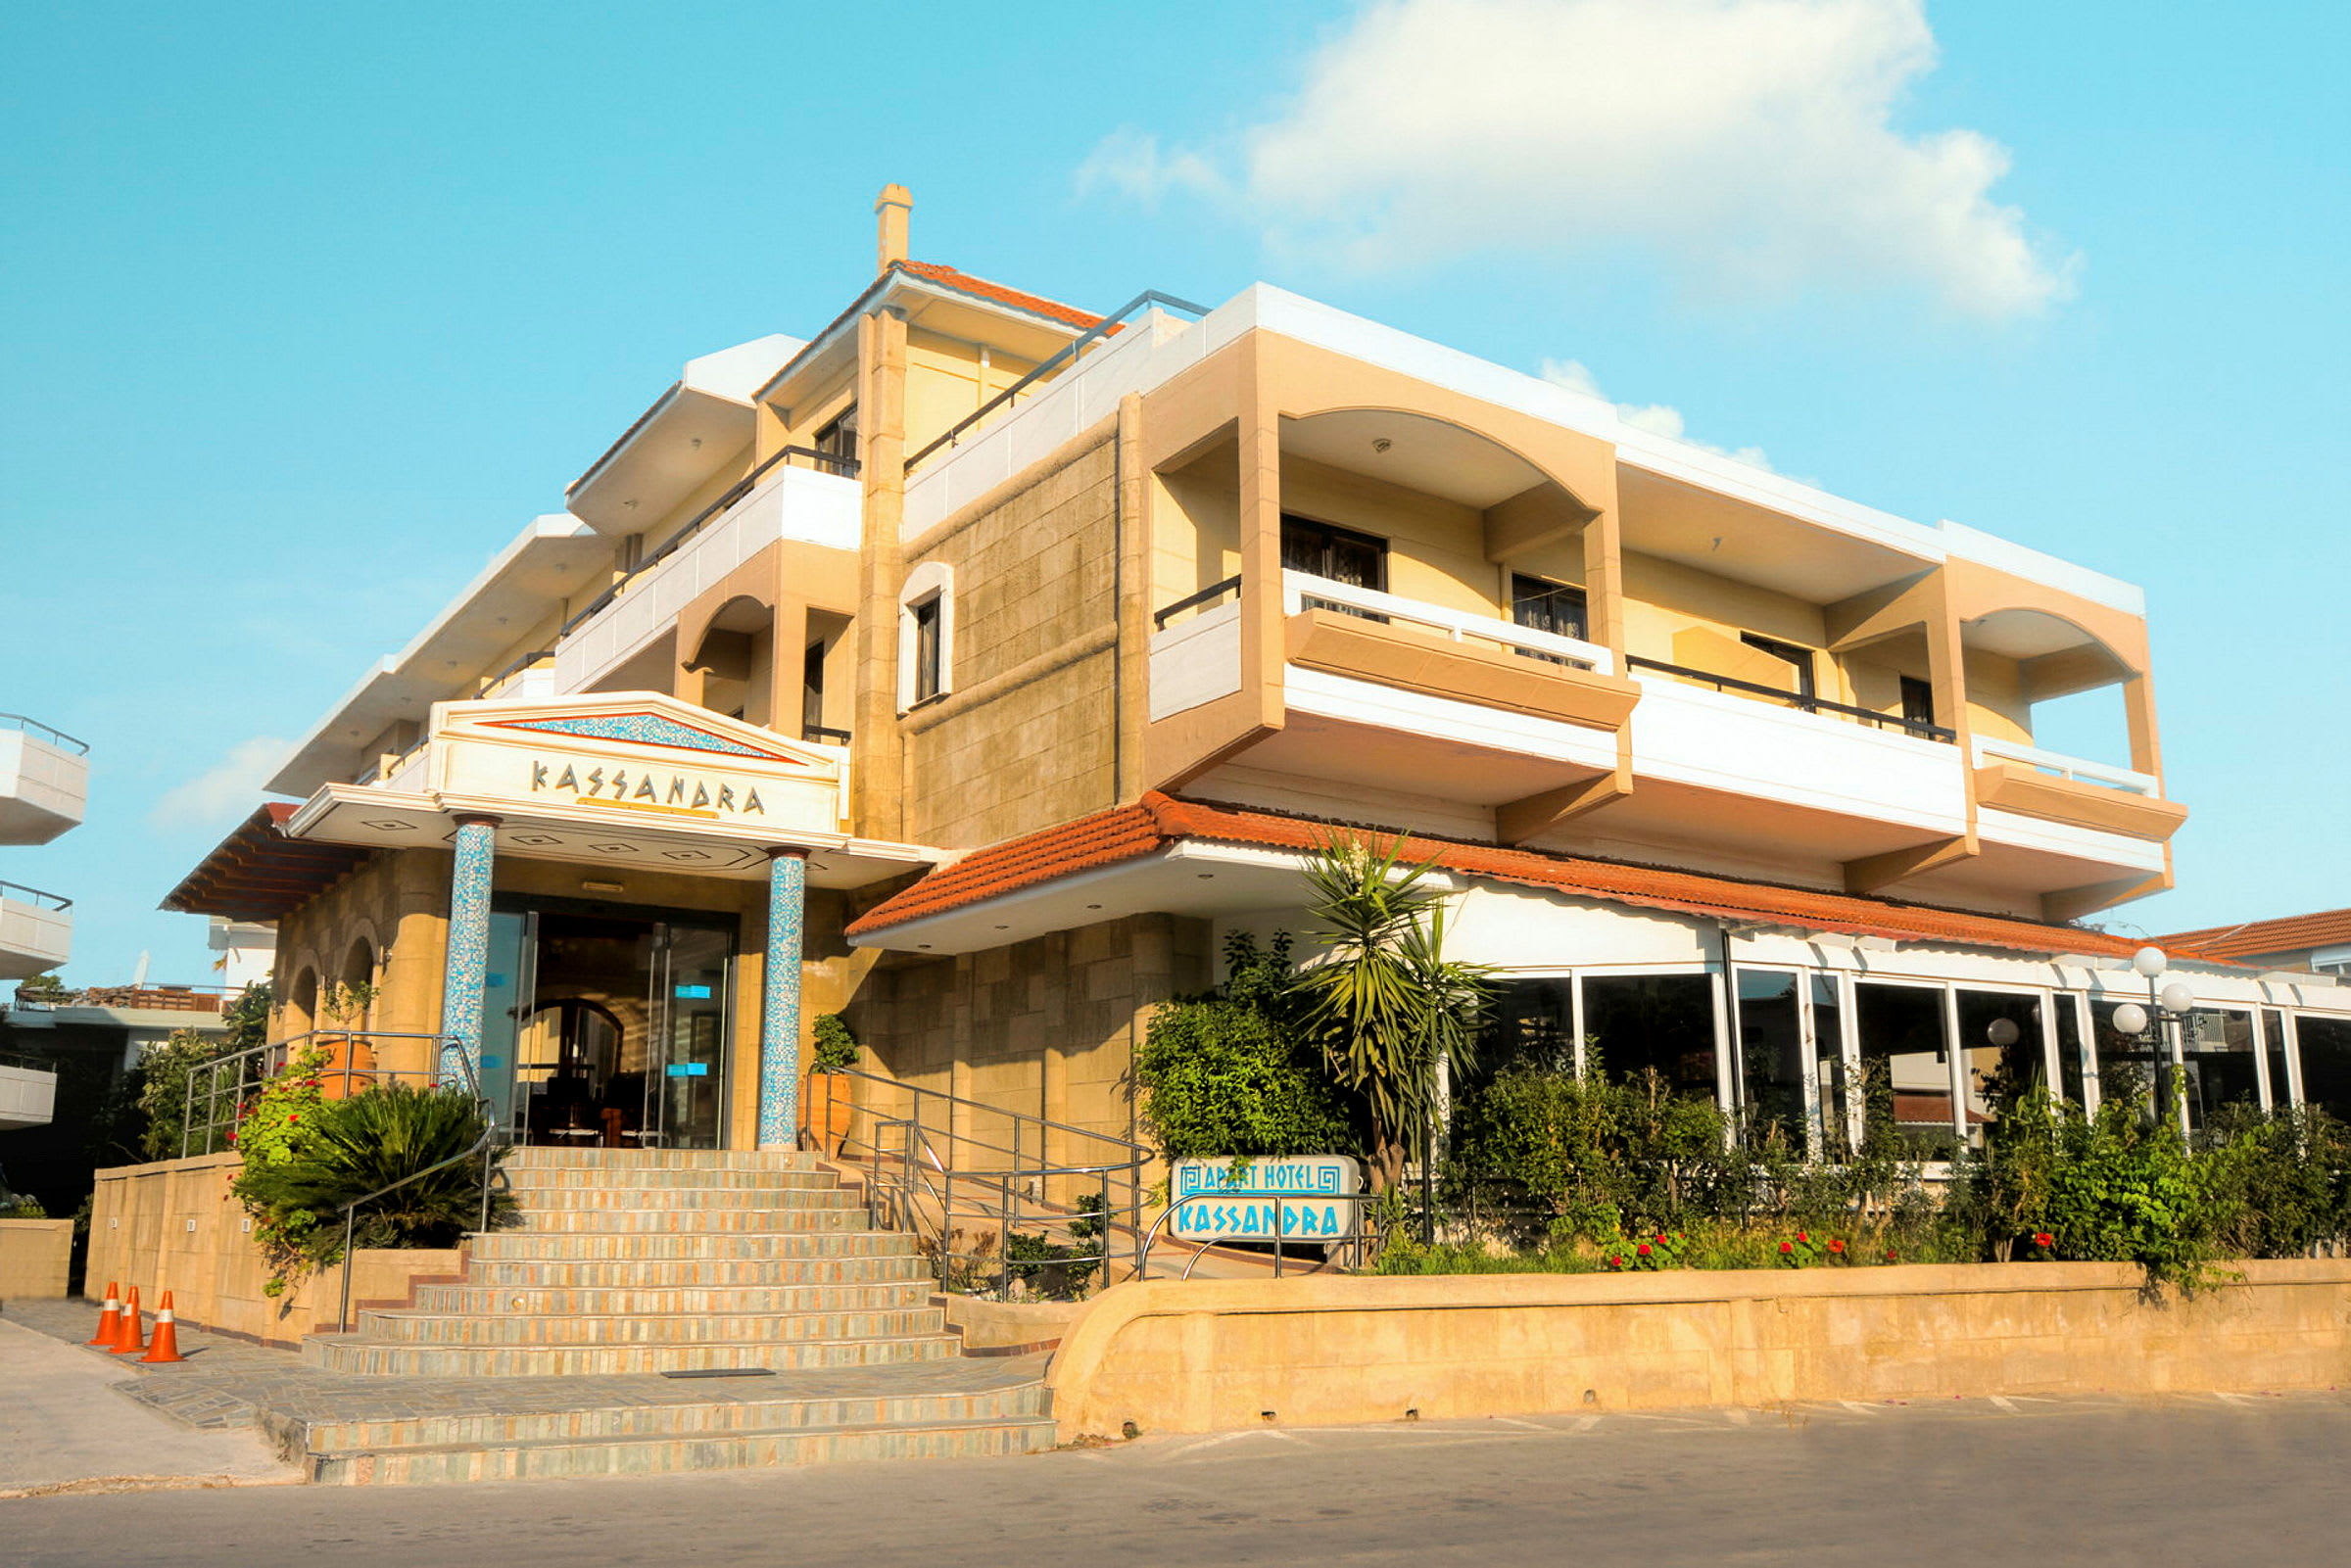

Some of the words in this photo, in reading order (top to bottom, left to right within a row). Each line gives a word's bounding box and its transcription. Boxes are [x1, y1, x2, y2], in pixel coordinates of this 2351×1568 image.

[532, 760, 765, 815] KASSANDRA
[1265, 1164, 1314, 1189] HOTEL
[1178, 1205, 1339, 1235] KASSANDRA
